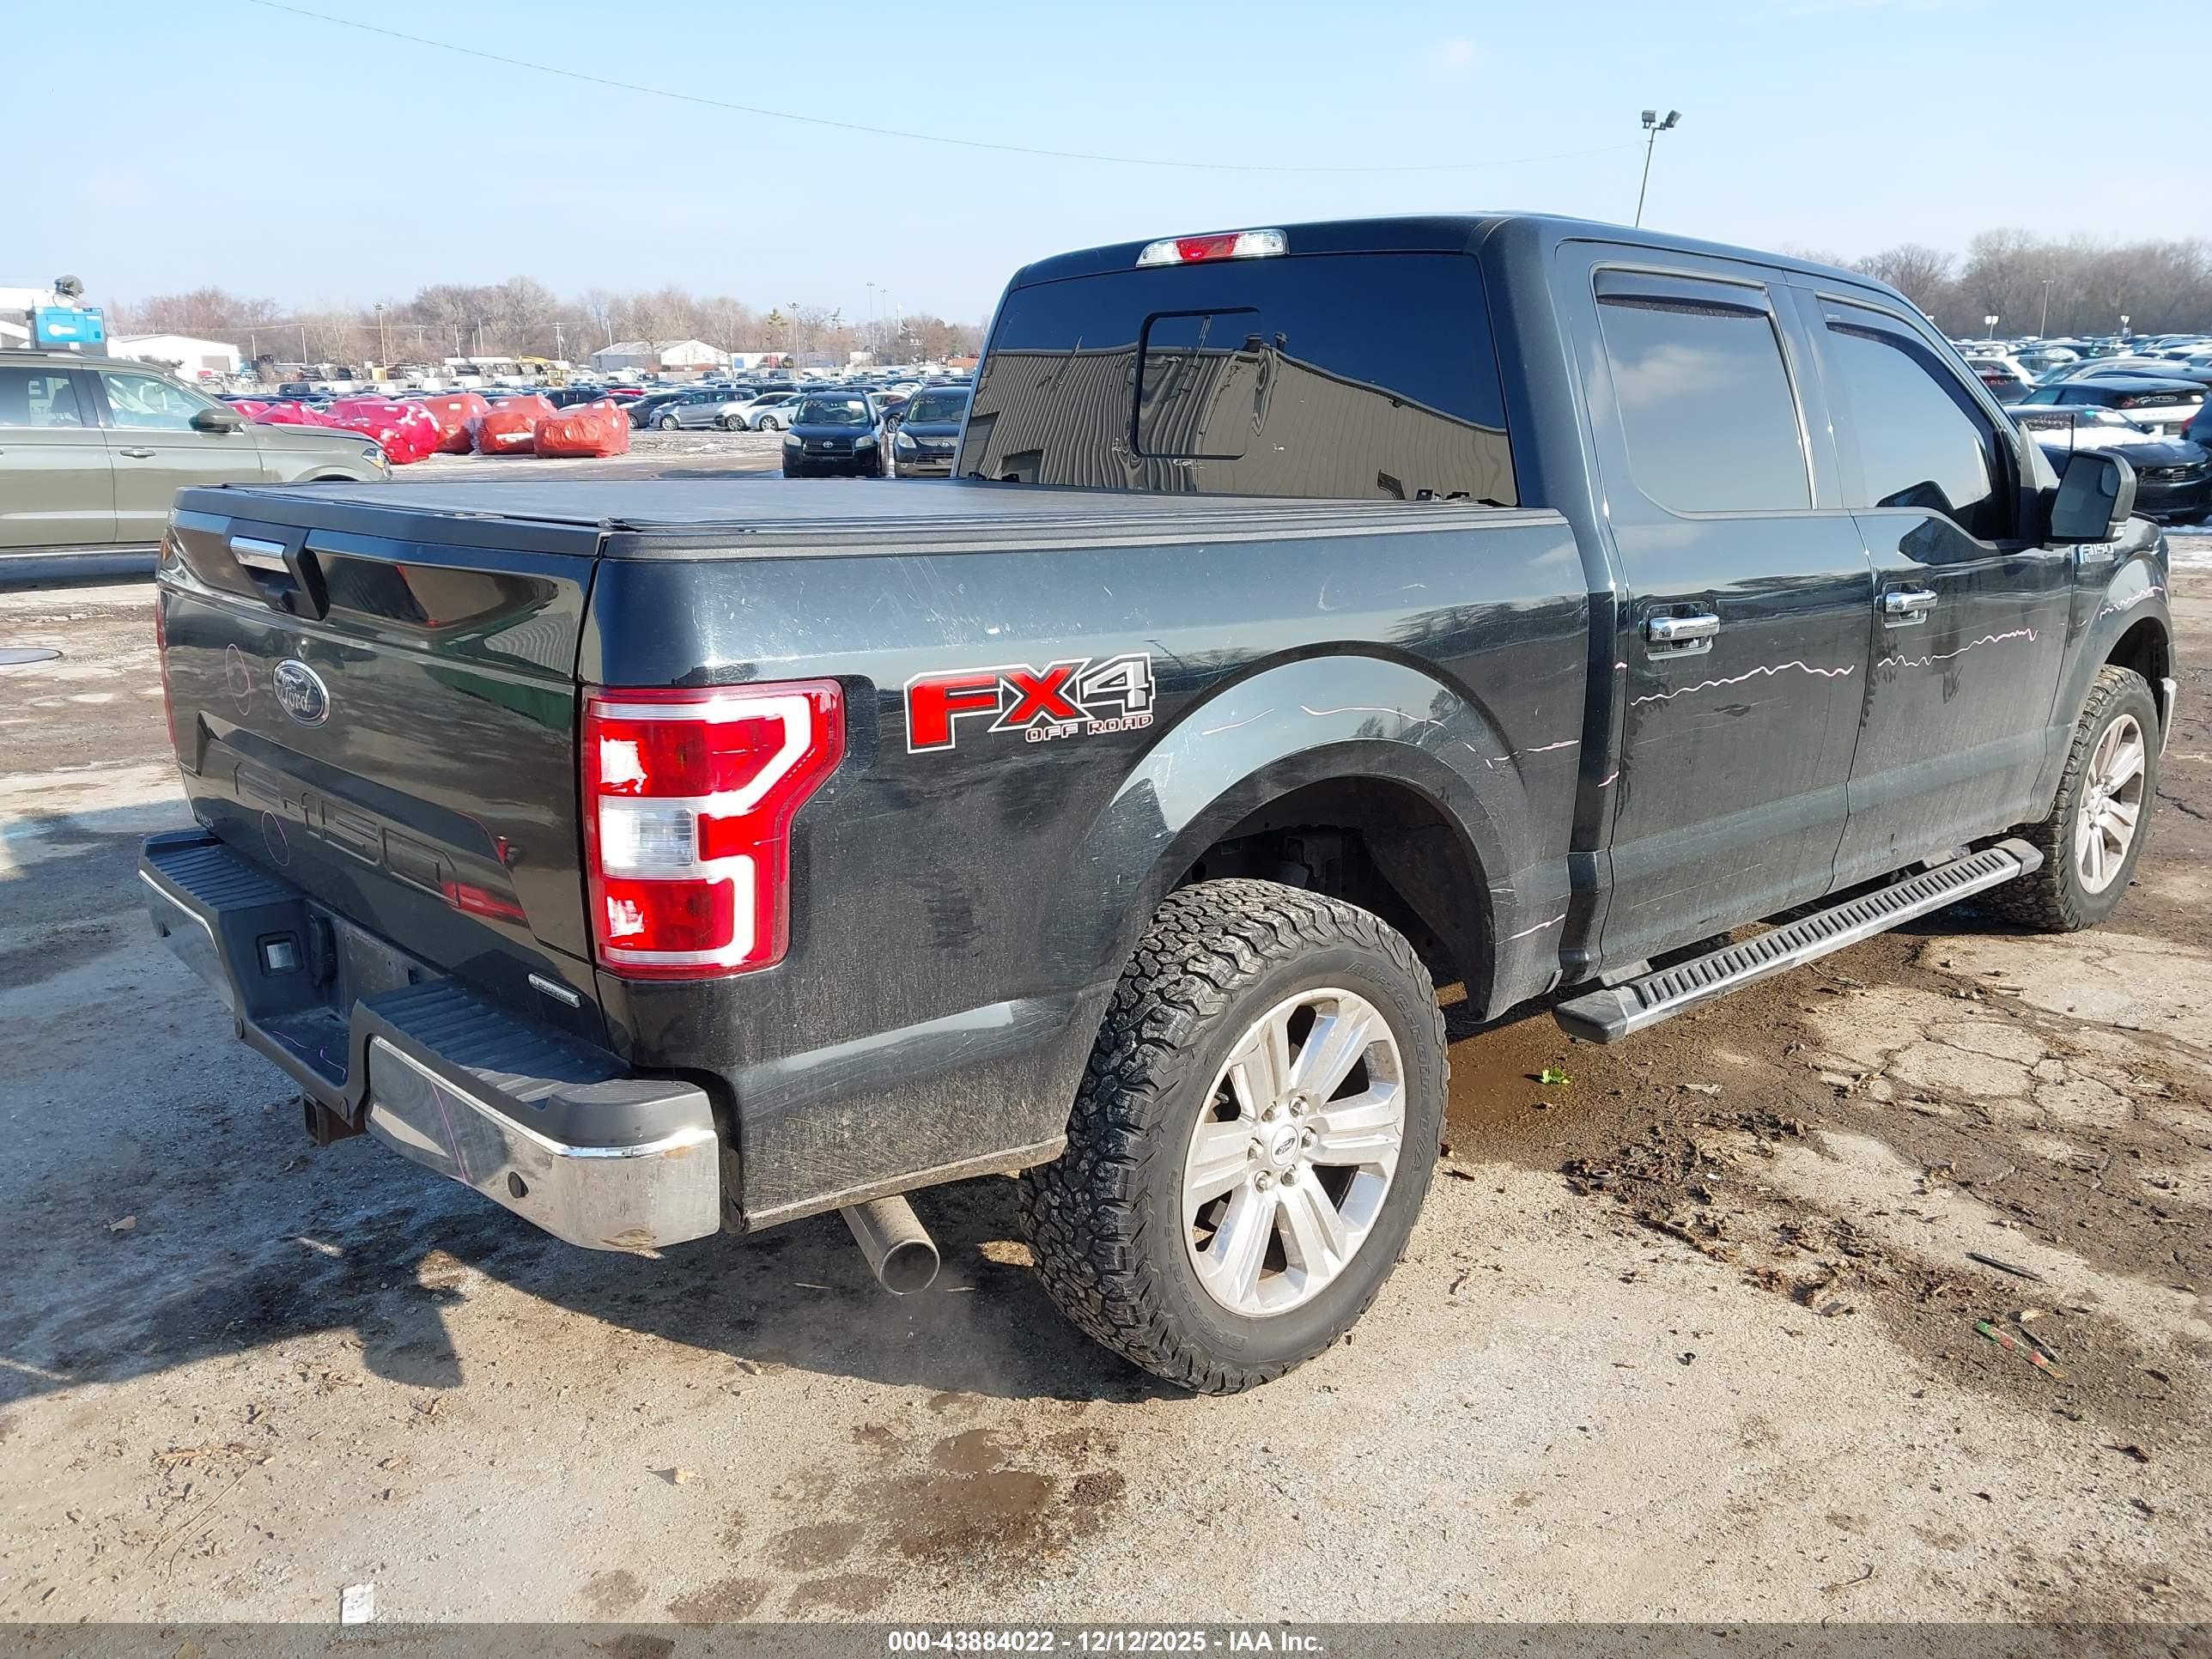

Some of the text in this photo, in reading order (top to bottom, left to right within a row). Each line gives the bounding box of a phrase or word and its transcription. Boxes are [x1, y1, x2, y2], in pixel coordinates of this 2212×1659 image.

[903, 653, 1157, 753] FX4
[1025, 714, 1154, 743] OFF ROAD
